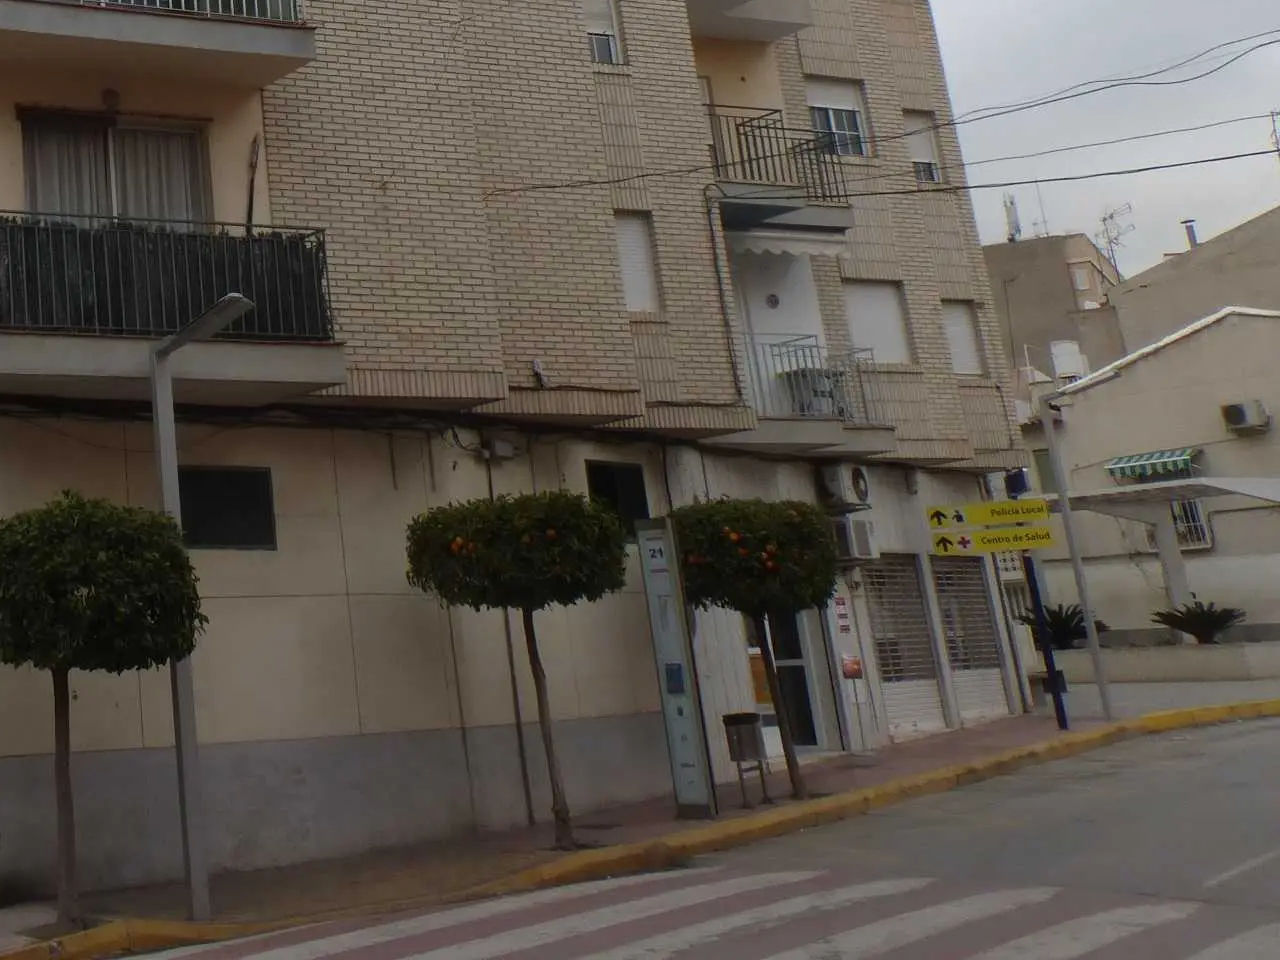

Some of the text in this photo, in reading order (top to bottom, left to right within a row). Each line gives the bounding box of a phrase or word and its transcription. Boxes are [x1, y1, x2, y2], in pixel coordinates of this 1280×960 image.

[1021, 504, 1044, 514] Local
[981, 531, 1050, 544] Centro de Salud
[649, 547, 663, 558] 21
